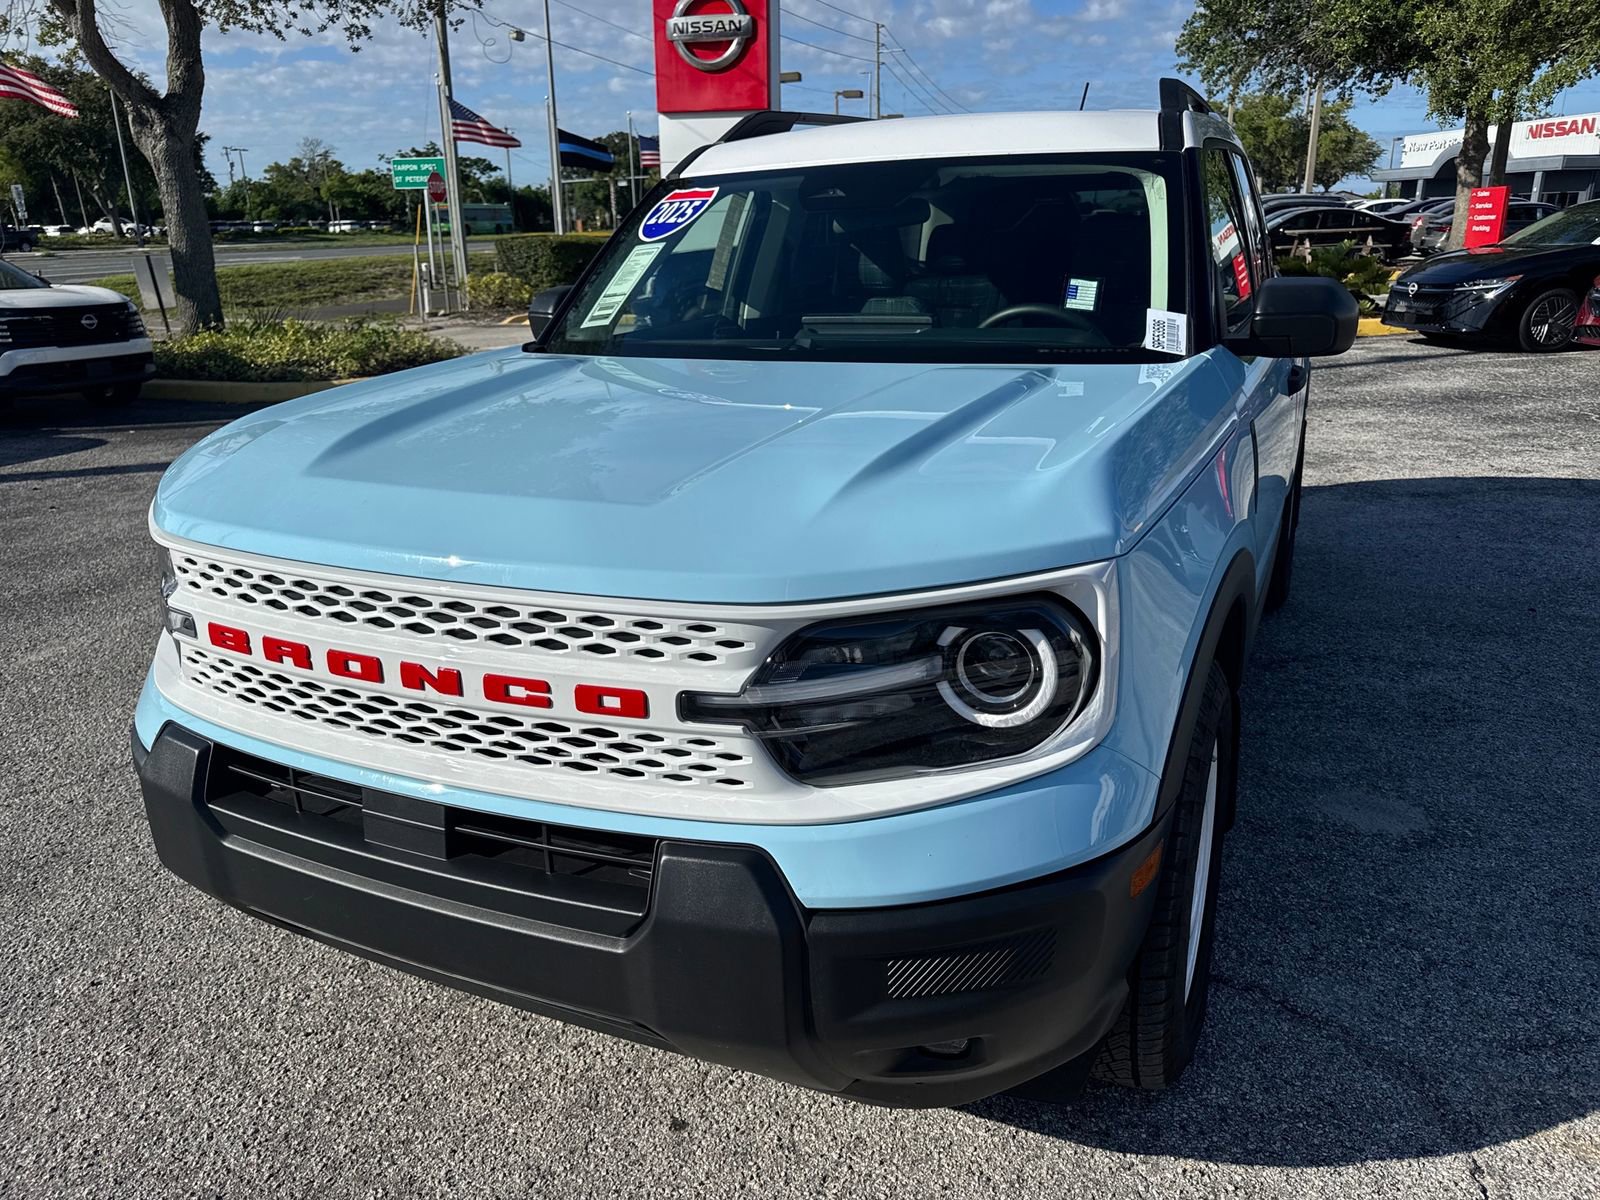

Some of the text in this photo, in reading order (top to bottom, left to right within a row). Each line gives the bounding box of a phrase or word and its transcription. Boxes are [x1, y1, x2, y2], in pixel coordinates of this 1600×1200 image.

[673, 20, 742, 34] NISSAN
[1526, 118, 1597, 140] NISSAN
[1429, 139, 1447, 150] Port
[405, 175, 429, 183] PETERS
[429, 181, 445, 193] STOP
[646, 201, 702, 225] 2025
[207, 621, 649, 720] BRONCO
